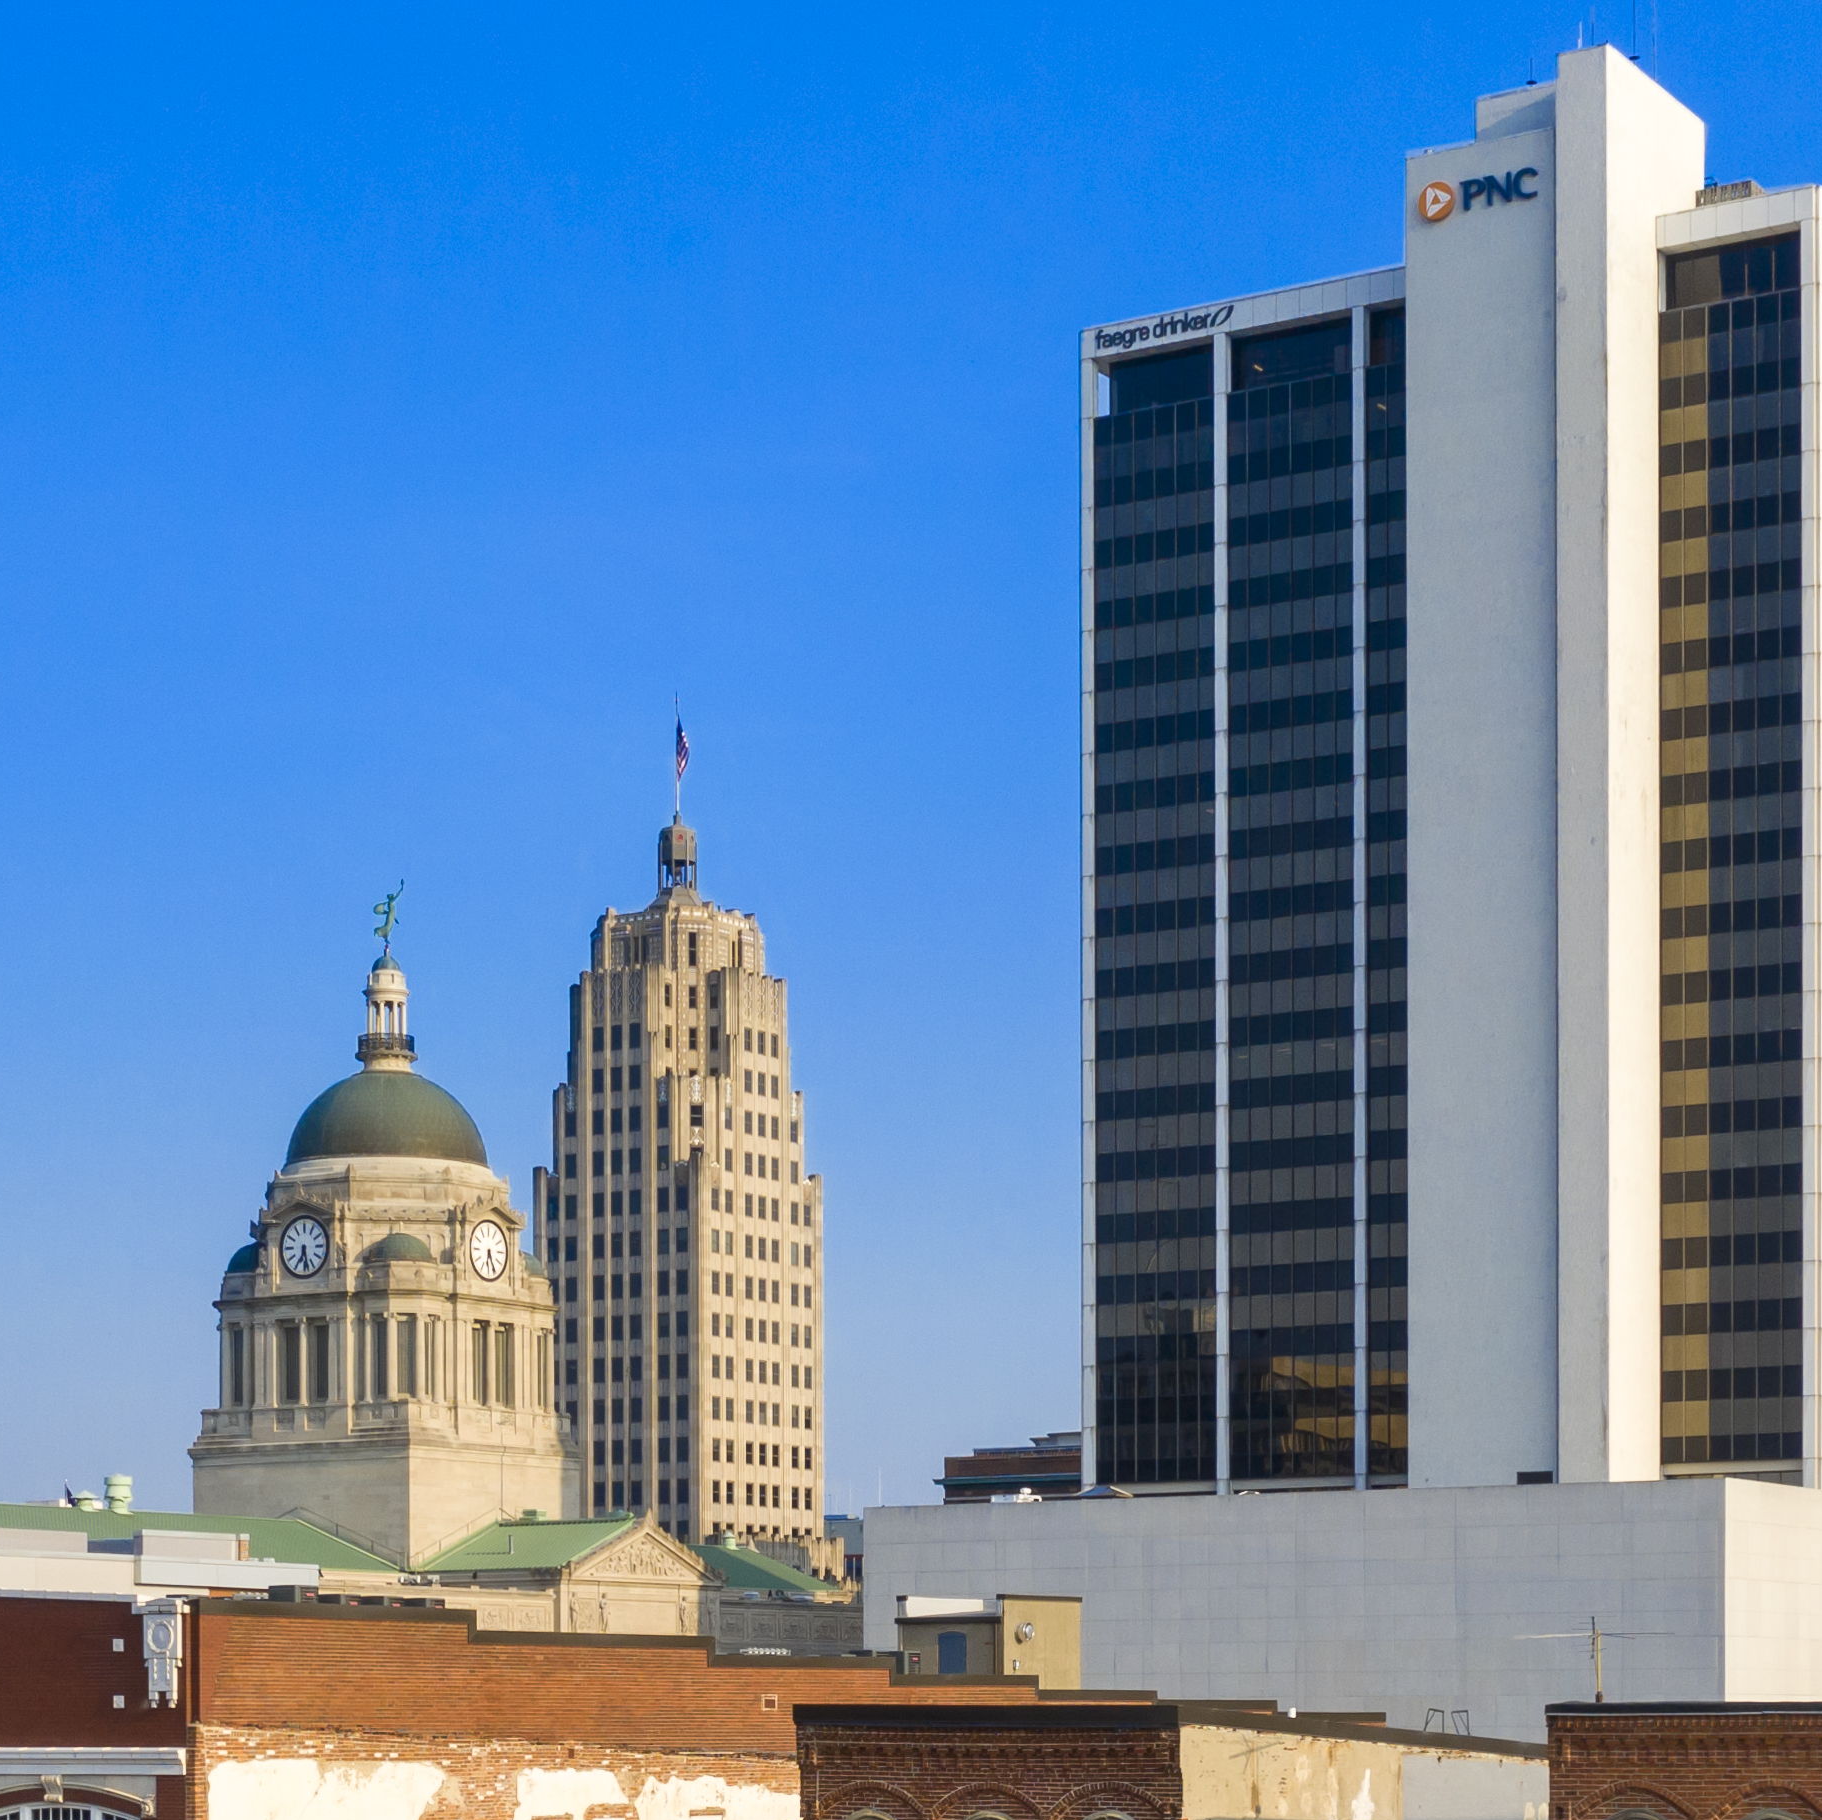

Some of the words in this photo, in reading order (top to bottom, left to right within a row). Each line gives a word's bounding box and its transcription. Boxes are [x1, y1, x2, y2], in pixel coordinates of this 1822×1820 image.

[1459, 167, 1538, 211] PNC
[1095, 327, 1150, 349] faegre
[1153, 312, 1211, 338] drinker
